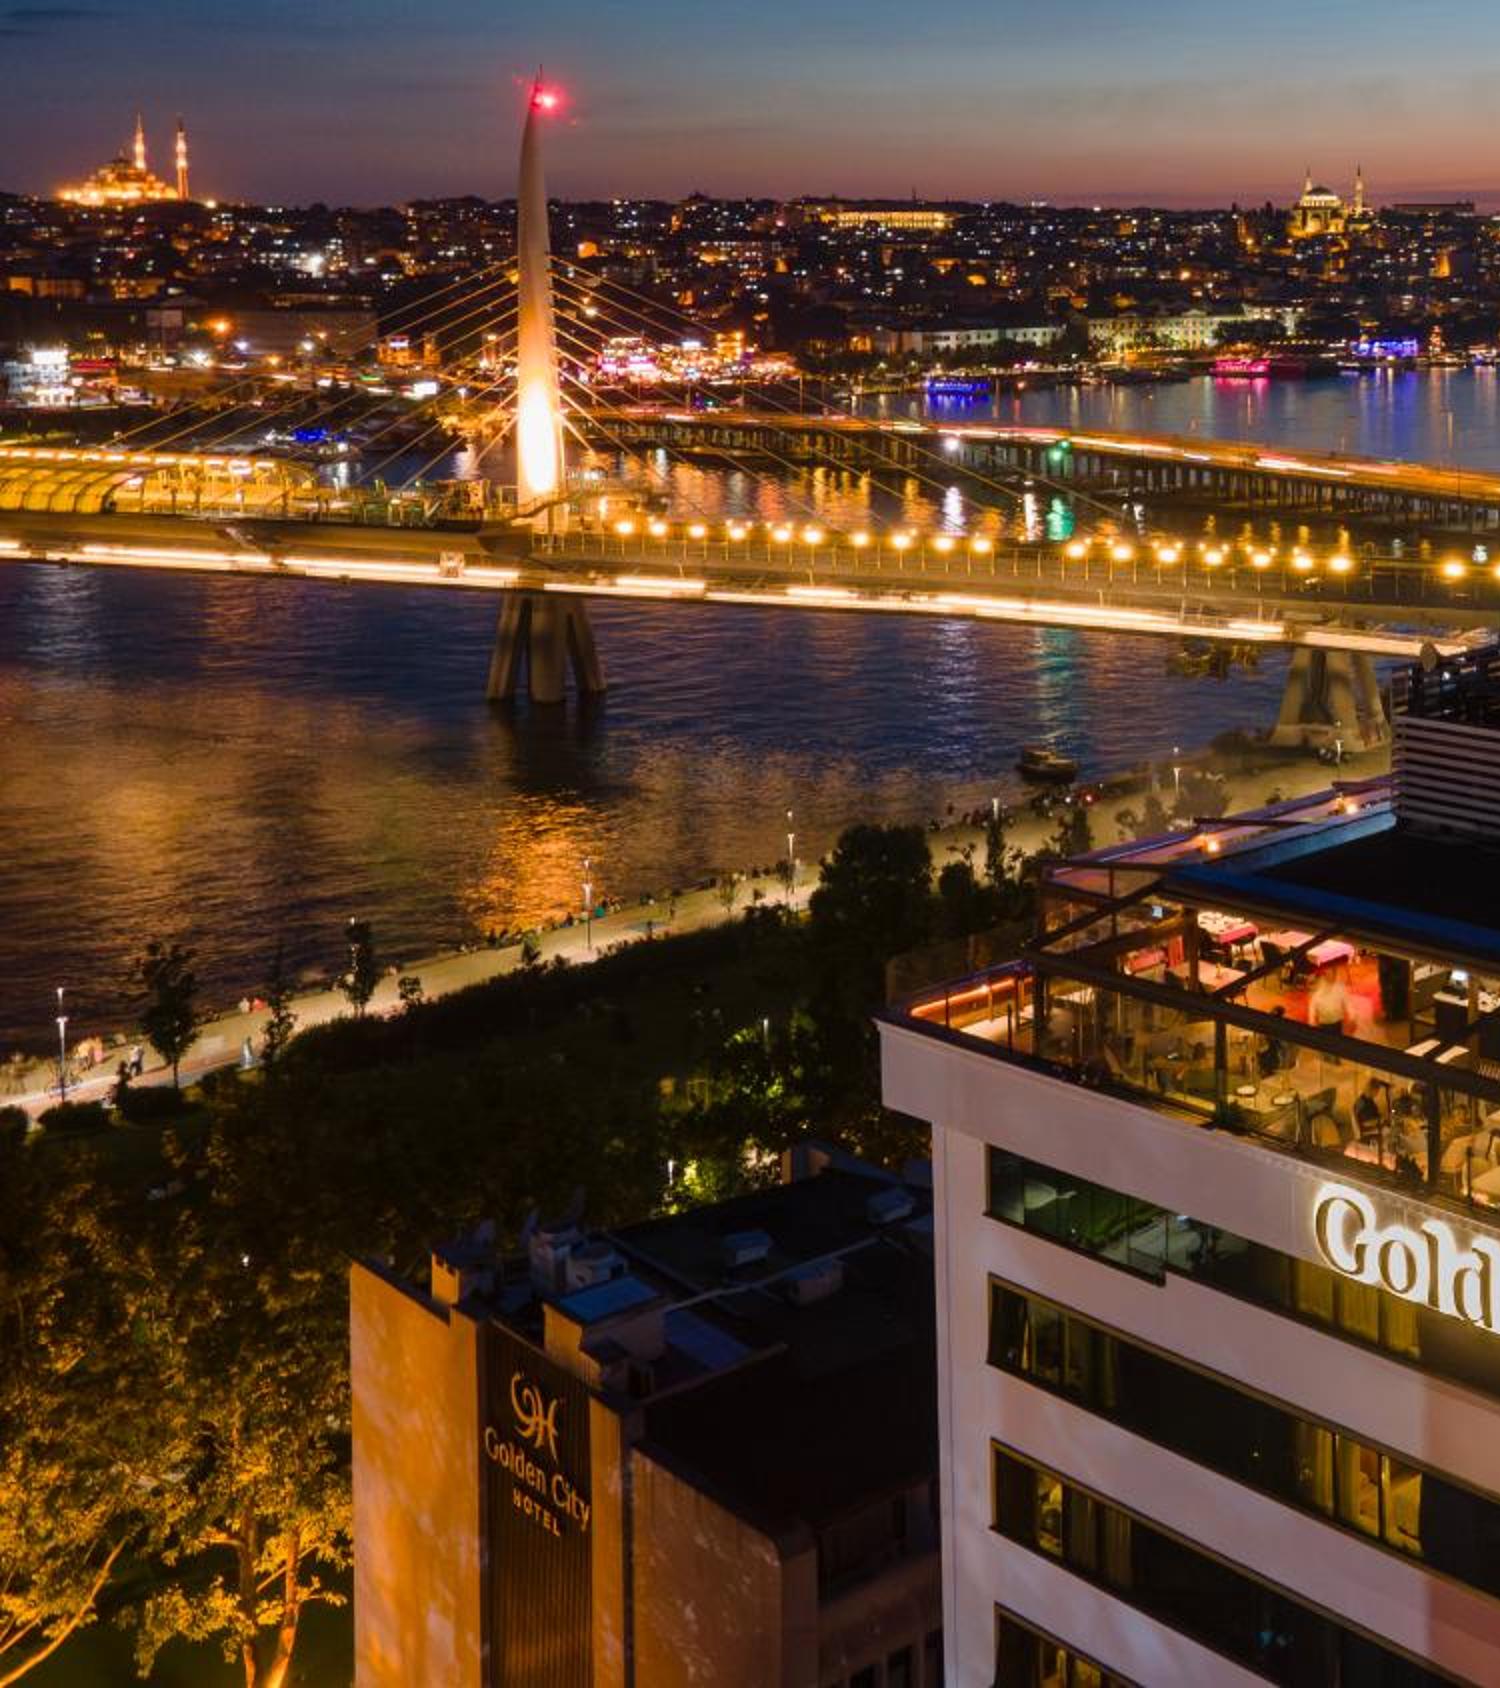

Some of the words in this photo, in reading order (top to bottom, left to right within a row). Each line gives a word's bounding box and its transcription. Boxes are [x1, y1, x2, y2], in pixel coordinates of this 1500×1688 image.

[485, 1427, 547, 1496] Golden
[552, 1475, 591, 1532] City
[513, 1488, 561, 1537] HOTEL
